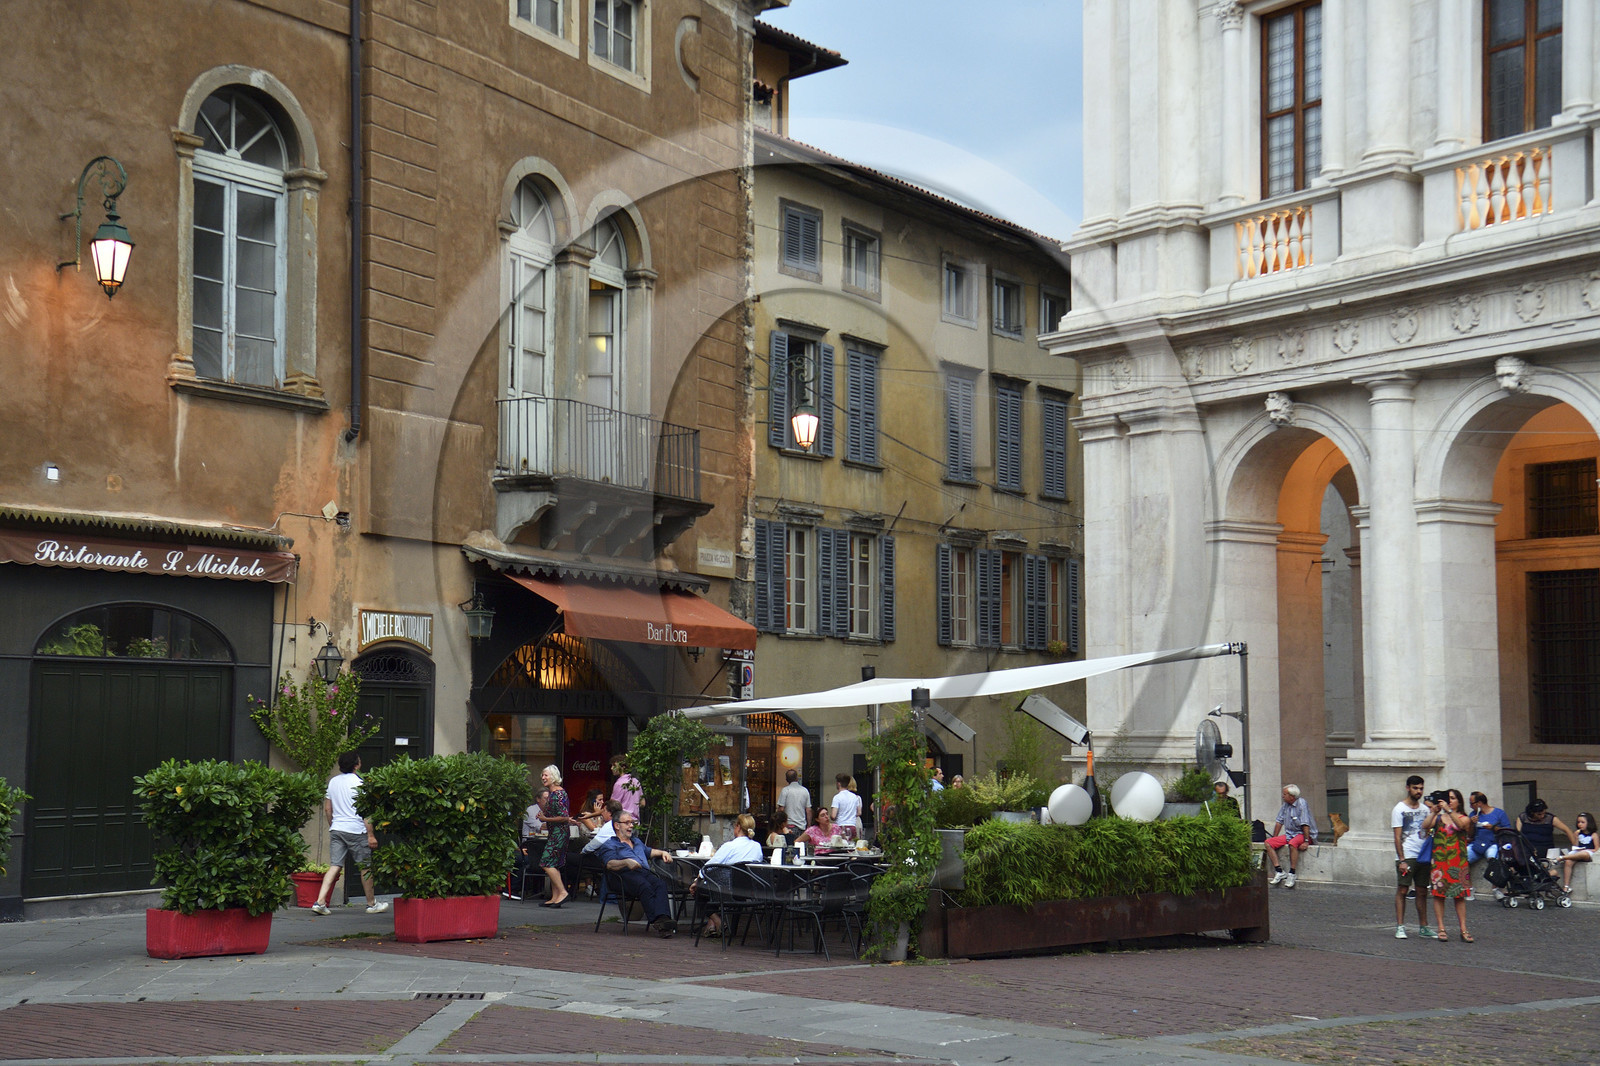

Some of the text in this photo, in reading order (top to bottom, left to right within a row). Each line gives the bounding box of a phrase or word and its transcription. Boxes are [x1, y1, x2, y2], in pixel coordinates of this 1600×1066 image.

[35, 540, 148, 569] Ristorante
[186, 554, 265, 577] Michele
[647, 622, 688, 643] Bar Flora
